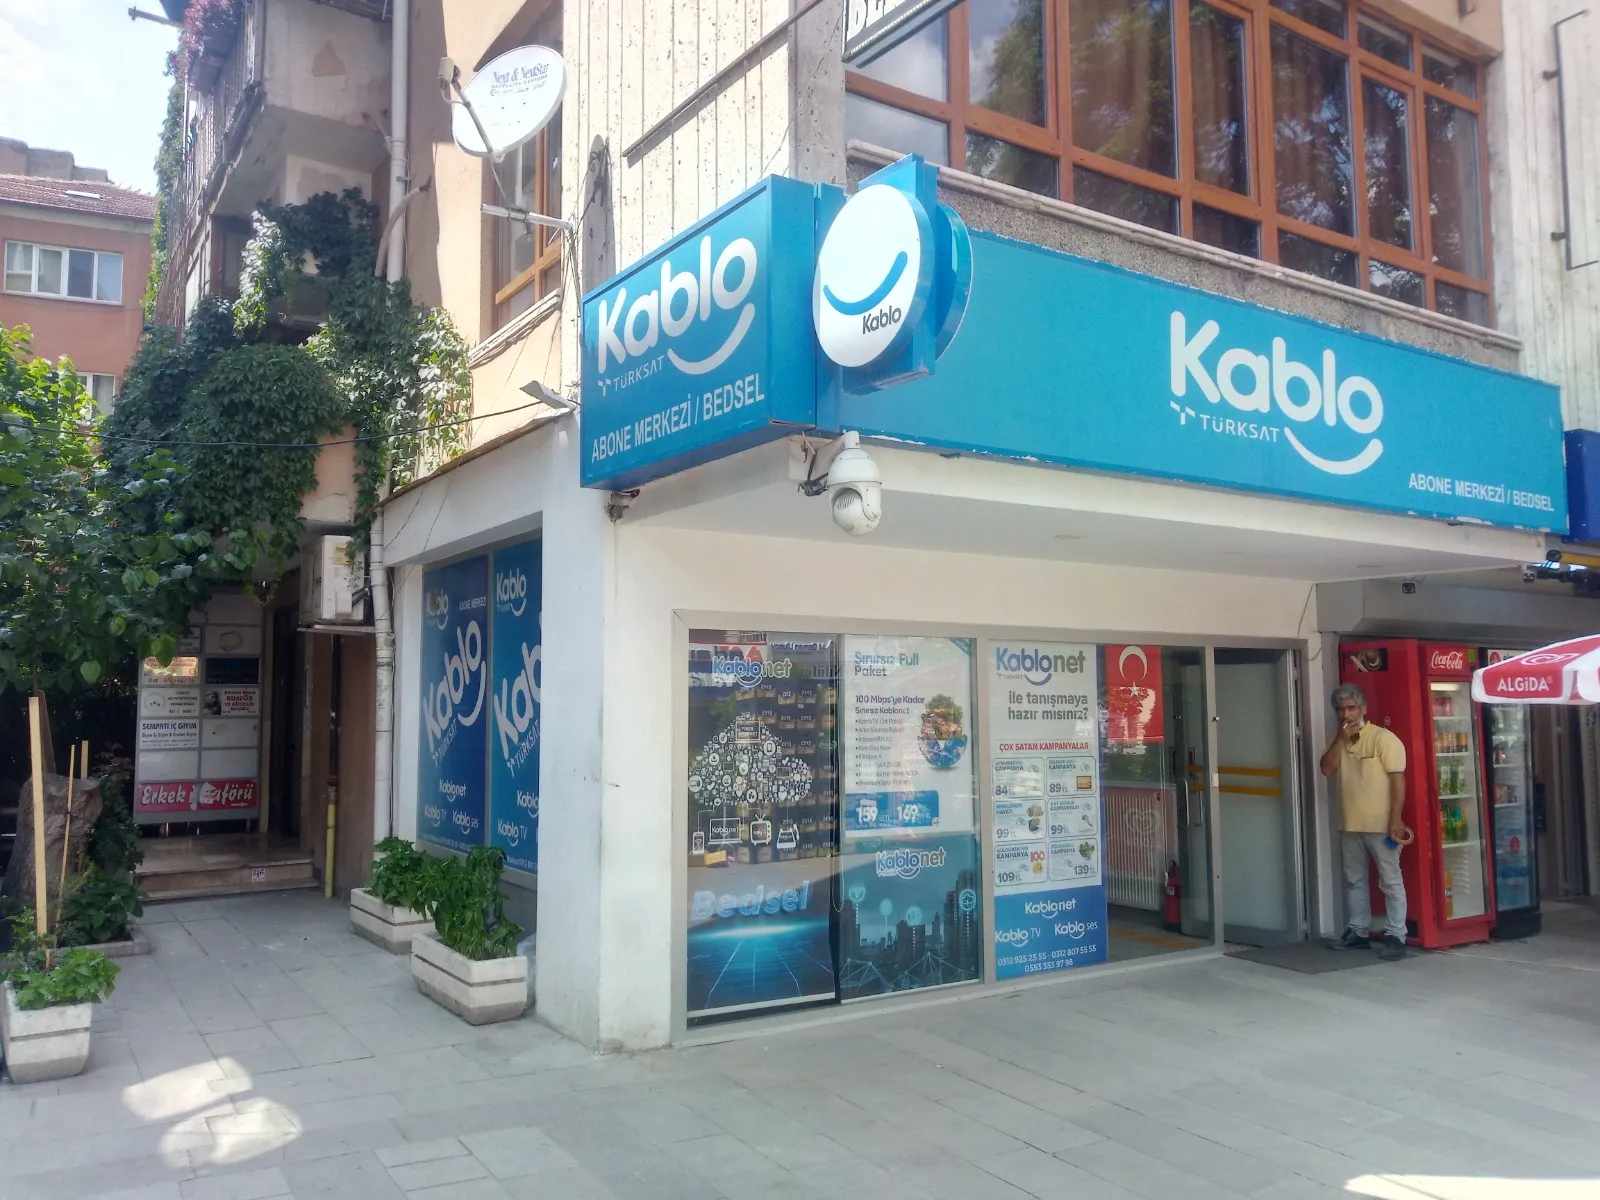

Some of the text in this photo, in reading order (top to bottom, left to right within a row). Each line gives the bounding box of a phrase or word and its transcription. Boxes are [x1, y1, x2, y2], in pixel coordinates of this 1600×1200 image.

[598, 235, 758, 374] Kablo
[862, 304, 902, 335] Kablo
[613, 355, 664, 392] TÜRKSAT
[1170, 310, 1384, 434] Kablo
[591, 425, 631, 464] ABONE
[634, 393, 692, 447] MERKEZİ
[703, 373, 765, 421] BEDSEL
[1199, 414, 1280, 442] TÜRKSAT
[1409, 472, 1452, 495] ABONE
[1454, 484, 1505, 504] MERKEZİ
[1513, 490, 1555, 512] BEDSEL
[497, 568, 527, 602] Kablo
[711, 656, 793, 678] Kablonet
[899, 653, 919, 666] Full
[996, 647, 1086, 674] Kablonet
[855, 665, 887, 677] Paket
[423, 619, 482, 753] Kablo
[855, 695, 925, 705] 100 Mbps'ye Kadar
[1008, 690, 1088, 708] ile tanışmaya
[880, 706, 910, 714] Kablonet
[1008, 706, 1089, 720] hazır mısınız?
[438, 718, 458, 762] TÜRKSAT
[515, 719, 541, 769] TÜRKSAT
[999, 742, 1089, 752] ÇOK SATAN KAMPANYALAR
[141, 785, 186, 806] Erkek
[439, 778, 467, 798] Kablonet
[995, 785, 1008, 796] 84
[1049, 783, 1061, 793] 89
[424, 804, 441, 822] Kablo
[453, 809, 471, 827] Kablo
[856, 806, 878, 823] 159
[897, 803, 919, 824] 169
[497, 819, 529, 839] Kablo TV
[997, 828, 1009, 838] 99
[1051, 825, 1063, 835] 99
[875, 846, 946, 870] Kablonet
[997, 851, 1029, 860] KAMPANYA
[1030, 851, 1045, 862] 100
[998, 872, 1015, 883] 109
[1074, 865, 1089, 876] 139
[690, 880, 811, 920] Bedsel
[1024, 898, 1077, 914] Kablonet
[995, 927, 1041, 943] Kablo TV
[1055, 921, 1098, 935] Kablo ses
[998, 957, 1014, 966] 0312
[1014, 955, 1027, 964] 925
[1029, 954, 1037, 962] 25
[1038, 952, 1047, 961] 55
[1051, 950, 1066, 959] 0312
[1067, 948, 1079, 956] 807
[1080, 946, 1088, 954] 55
[1088, 945, 1097, 953] 55
[1025, 963, 1042, 973] 0553
[1043, 961, 1055, 970] 353
[1056, 960, 1064, 968] 97
